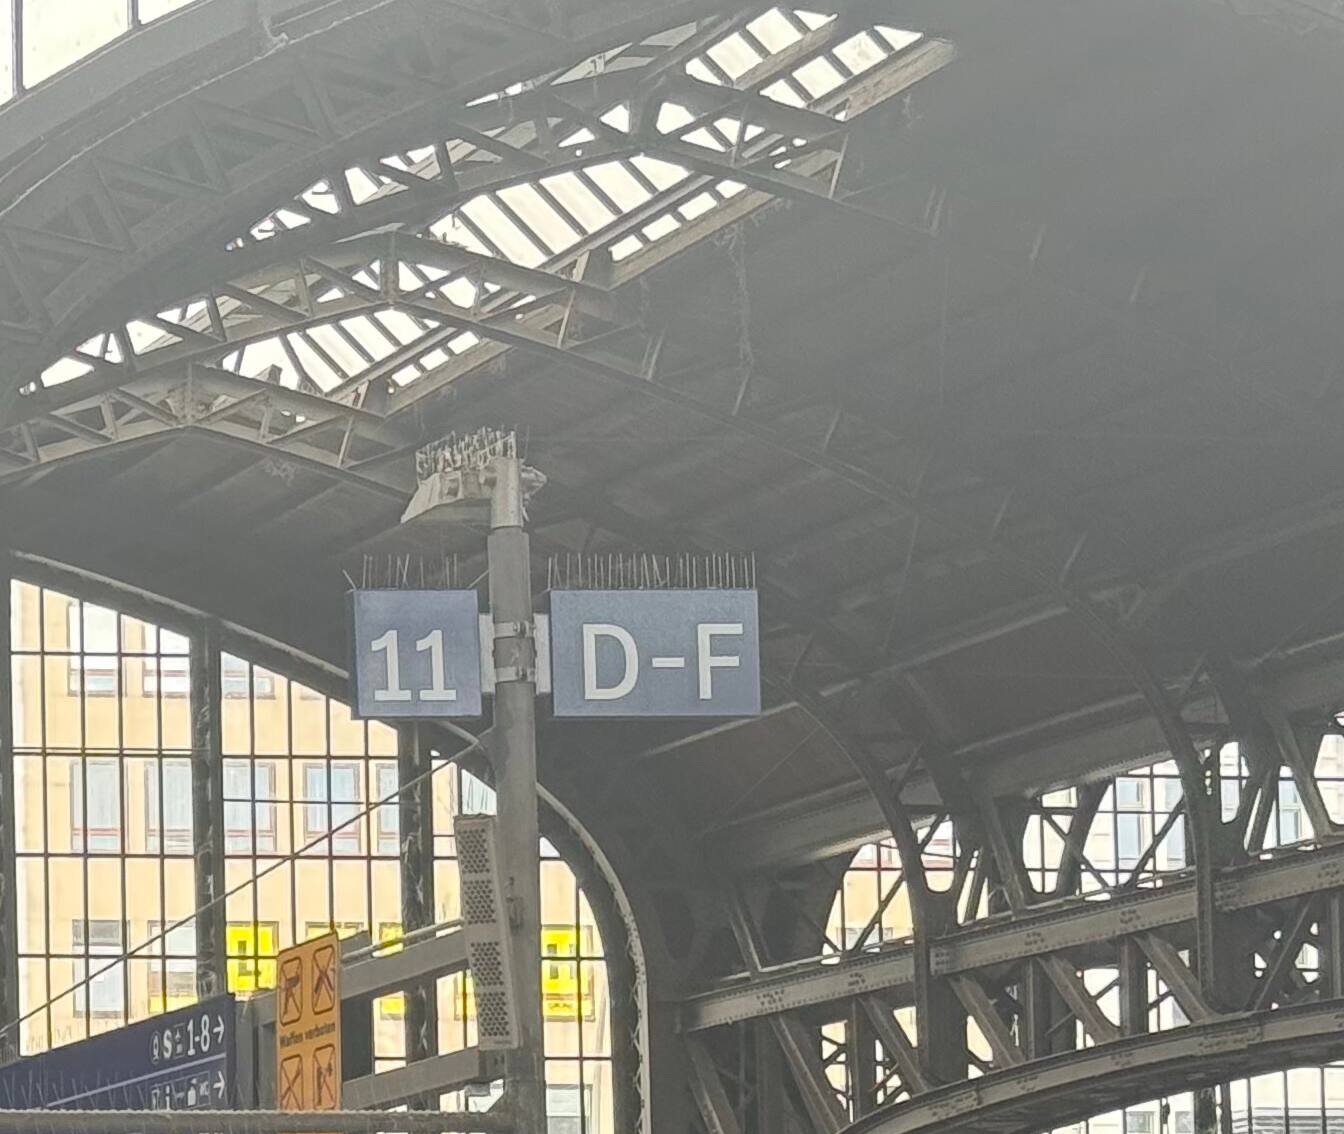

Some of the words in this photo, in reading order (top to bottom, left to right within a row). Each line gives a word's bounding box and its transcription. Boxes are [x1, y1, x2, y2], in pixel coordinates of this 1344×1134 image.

[370, 628, 458, 702] 11
[581, 623, 744, 701] D-F
[186, 1013, 211, 1057] 1-8
